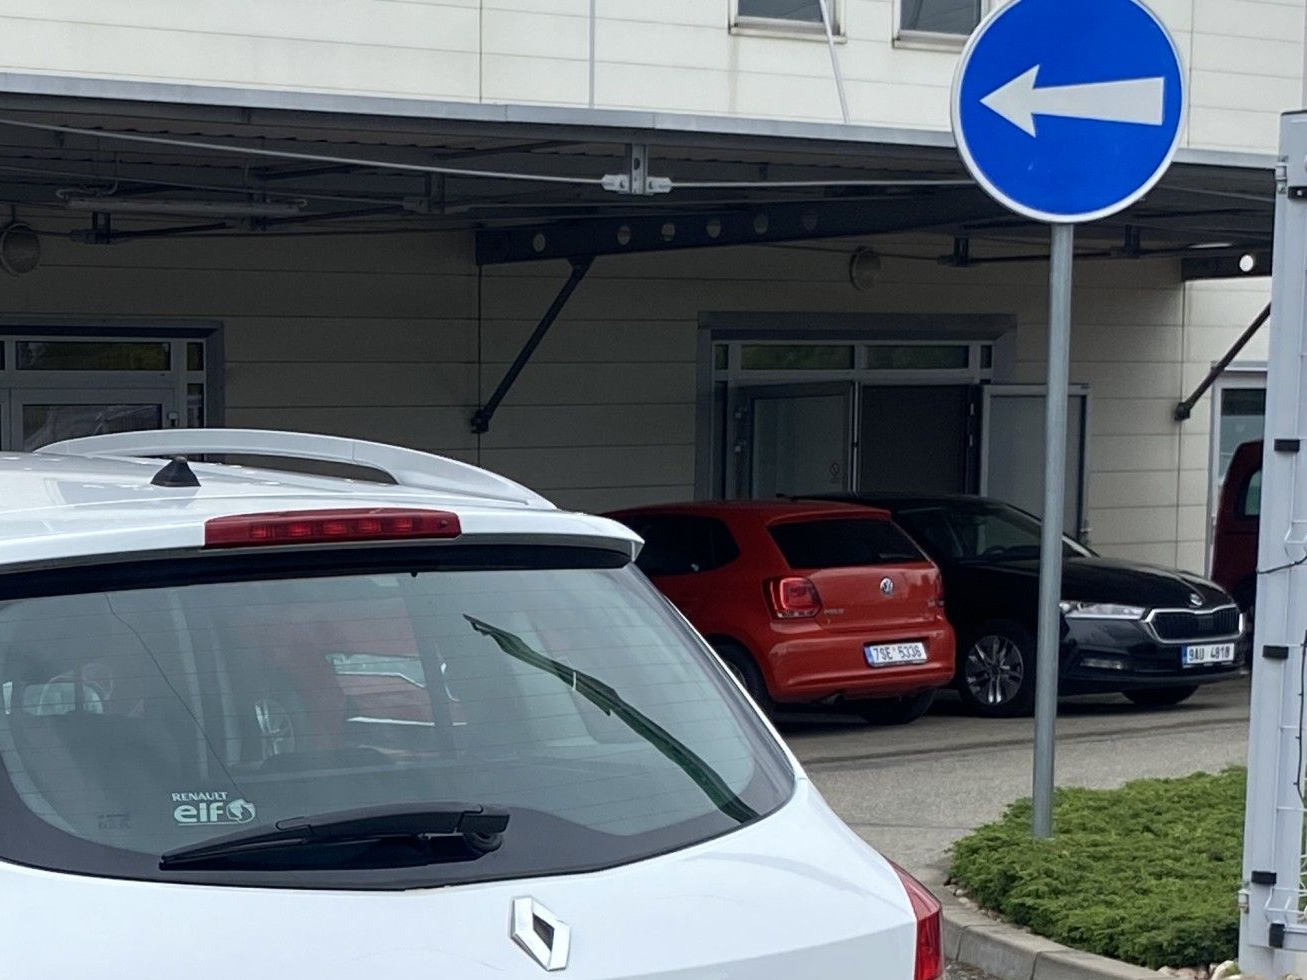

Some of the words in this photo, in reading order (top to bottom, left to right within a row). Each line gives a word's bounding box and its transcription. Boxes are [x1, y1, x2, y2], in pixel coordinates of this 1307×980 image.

[873, 646, 894, 661] 7SE
[1188, 647, 1205, 662] 9AU
[171, 791, 228, 802] RENAULT
[173, 802, 224, 823] elf
